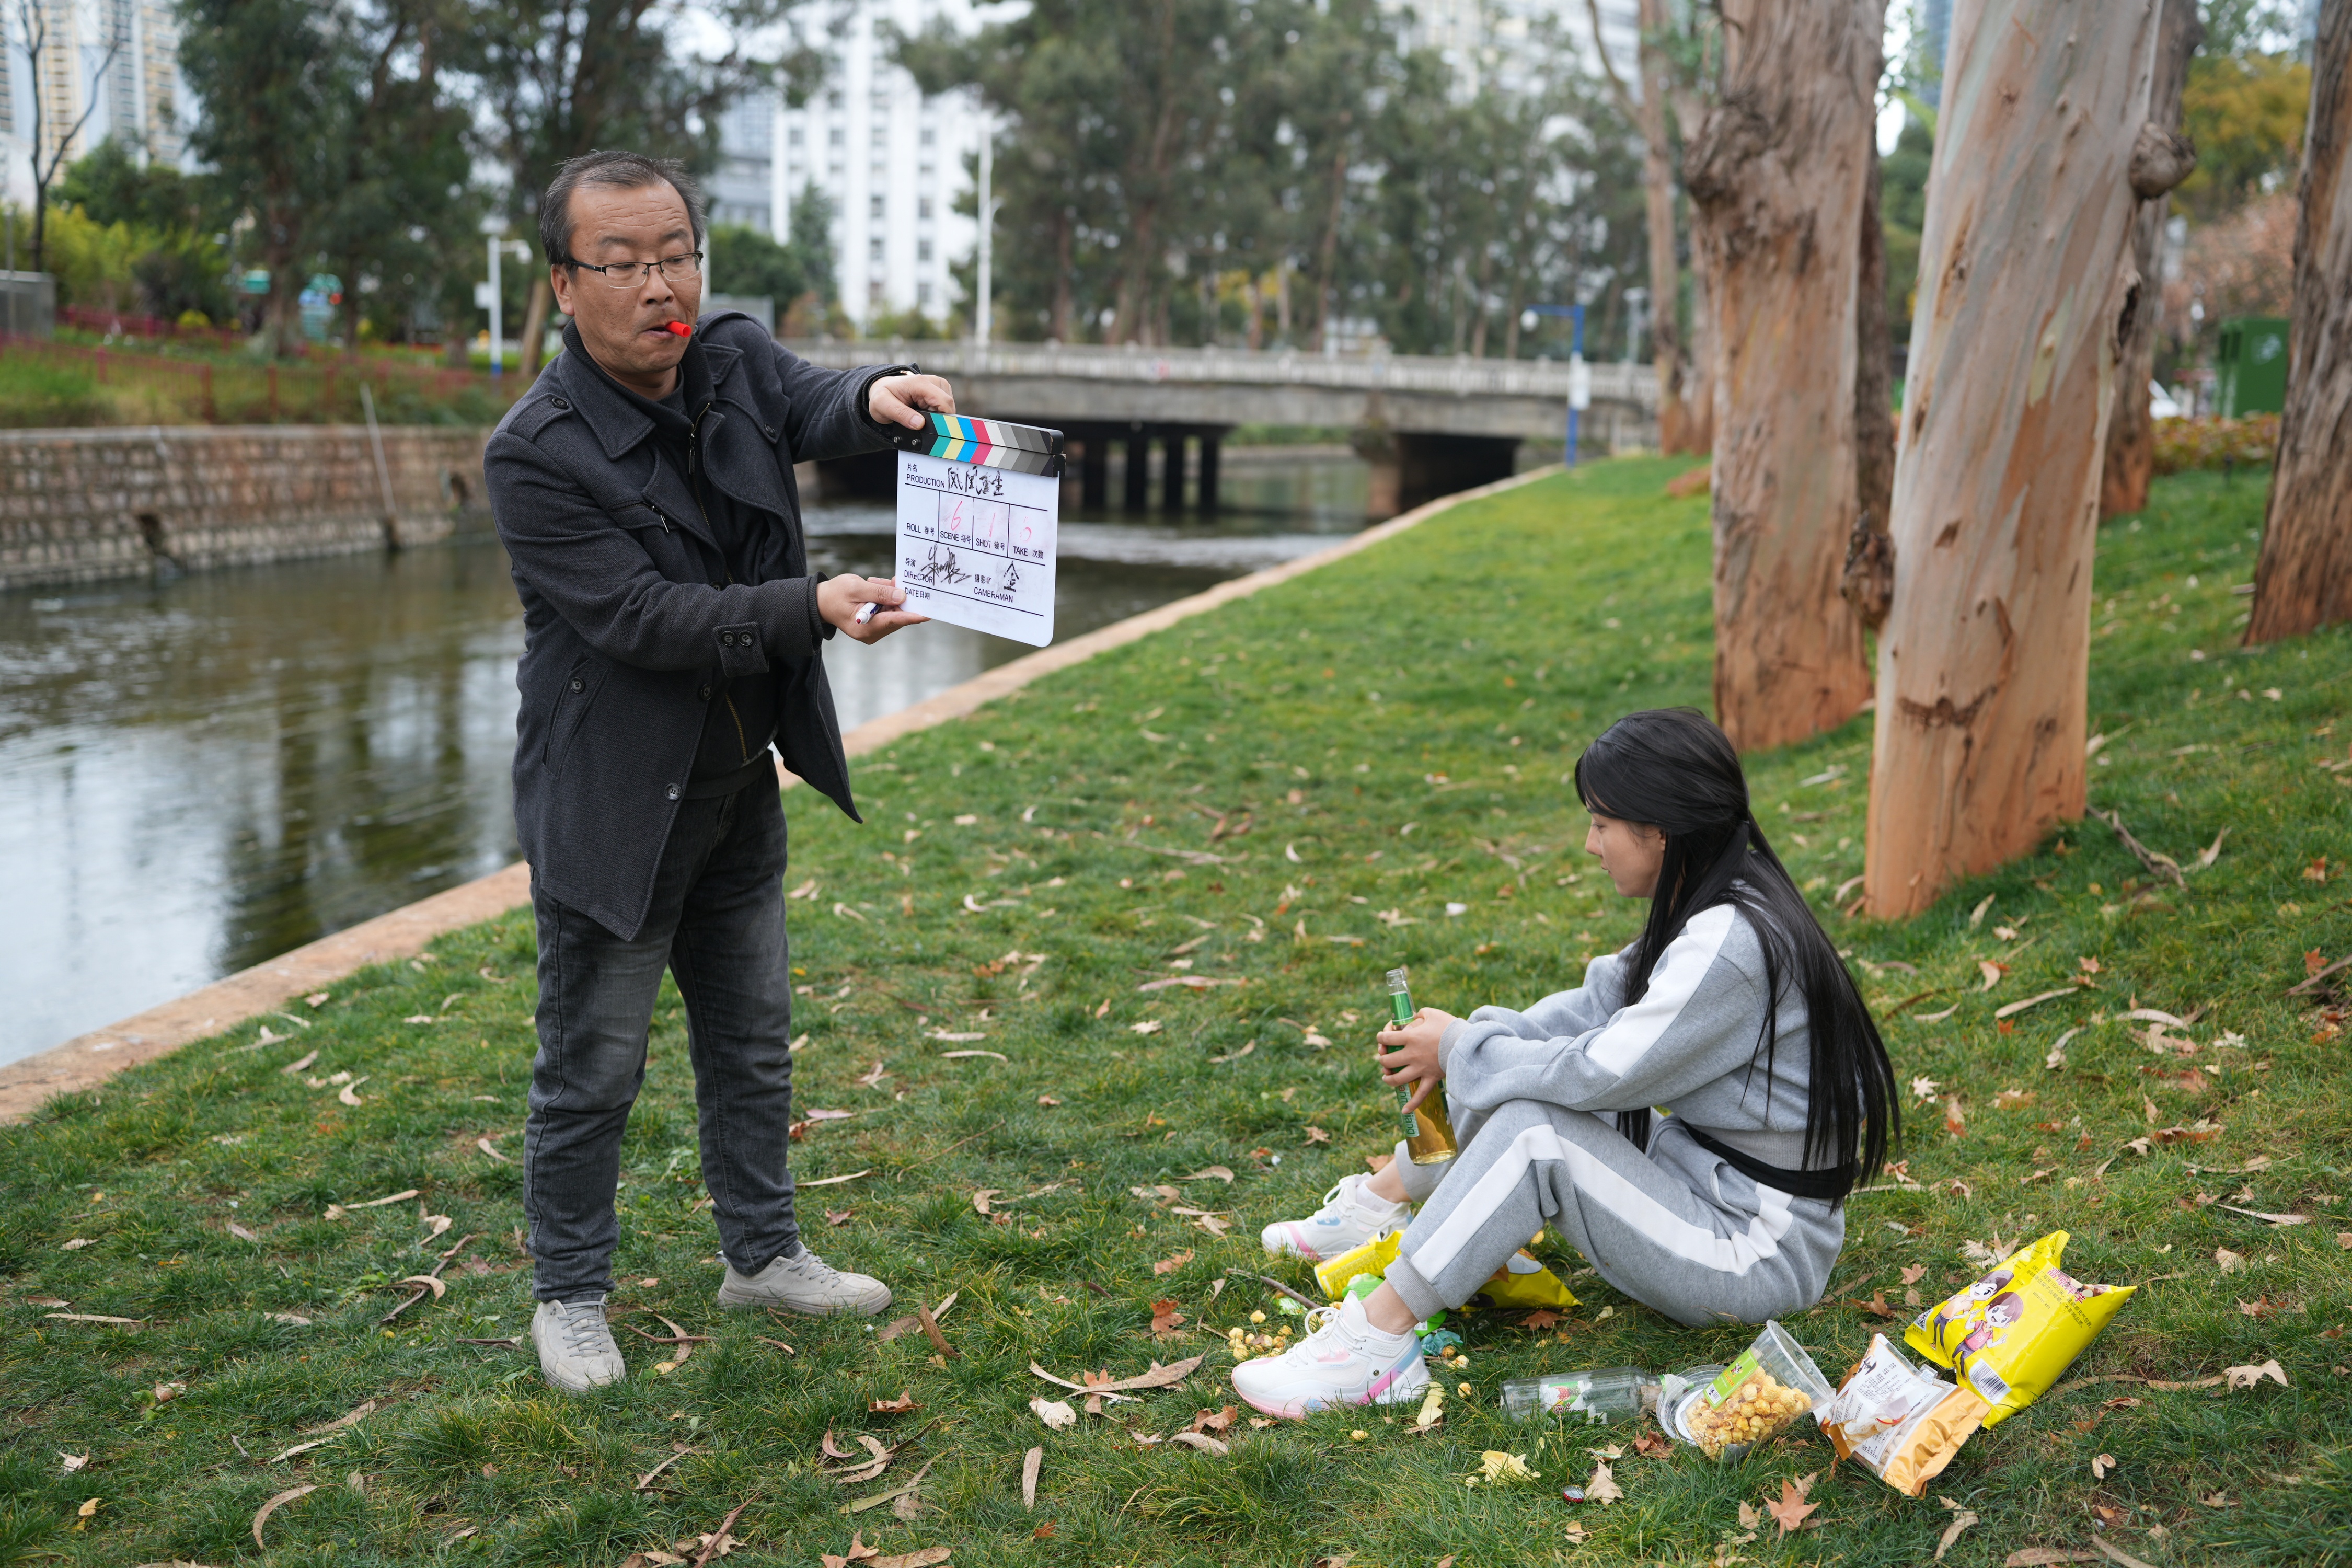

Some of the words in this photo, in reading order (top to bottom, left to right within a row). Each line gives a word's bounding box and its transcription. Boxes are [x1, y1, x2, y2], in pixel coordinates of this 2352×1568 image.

[907, 463, 917, 472] 片名
[907, 474, 945, 488] PRODUCTION
[951, 501, 962, 531] 6
[906, 523, 921, 533] ROLL
[924, 526, 935, 536] 卷号
[940, 531, 959, 541] SCENE
[961, 534, 971, 544] 场号
[976, 538, 990, 548] SHOT
[994, 541, 1005, 550] 镜号
[1013, 546, 1028, 556] TAKE
[1032, 549, 1044, 559] 次数
[905, 557, 916, 567] 导演
[904, 570, 933, 583] DIRECTOR
[974, 586, 1013, 603] CAMERAMAN
[2047, 1267, 2086, 1304] 高原洋芋
